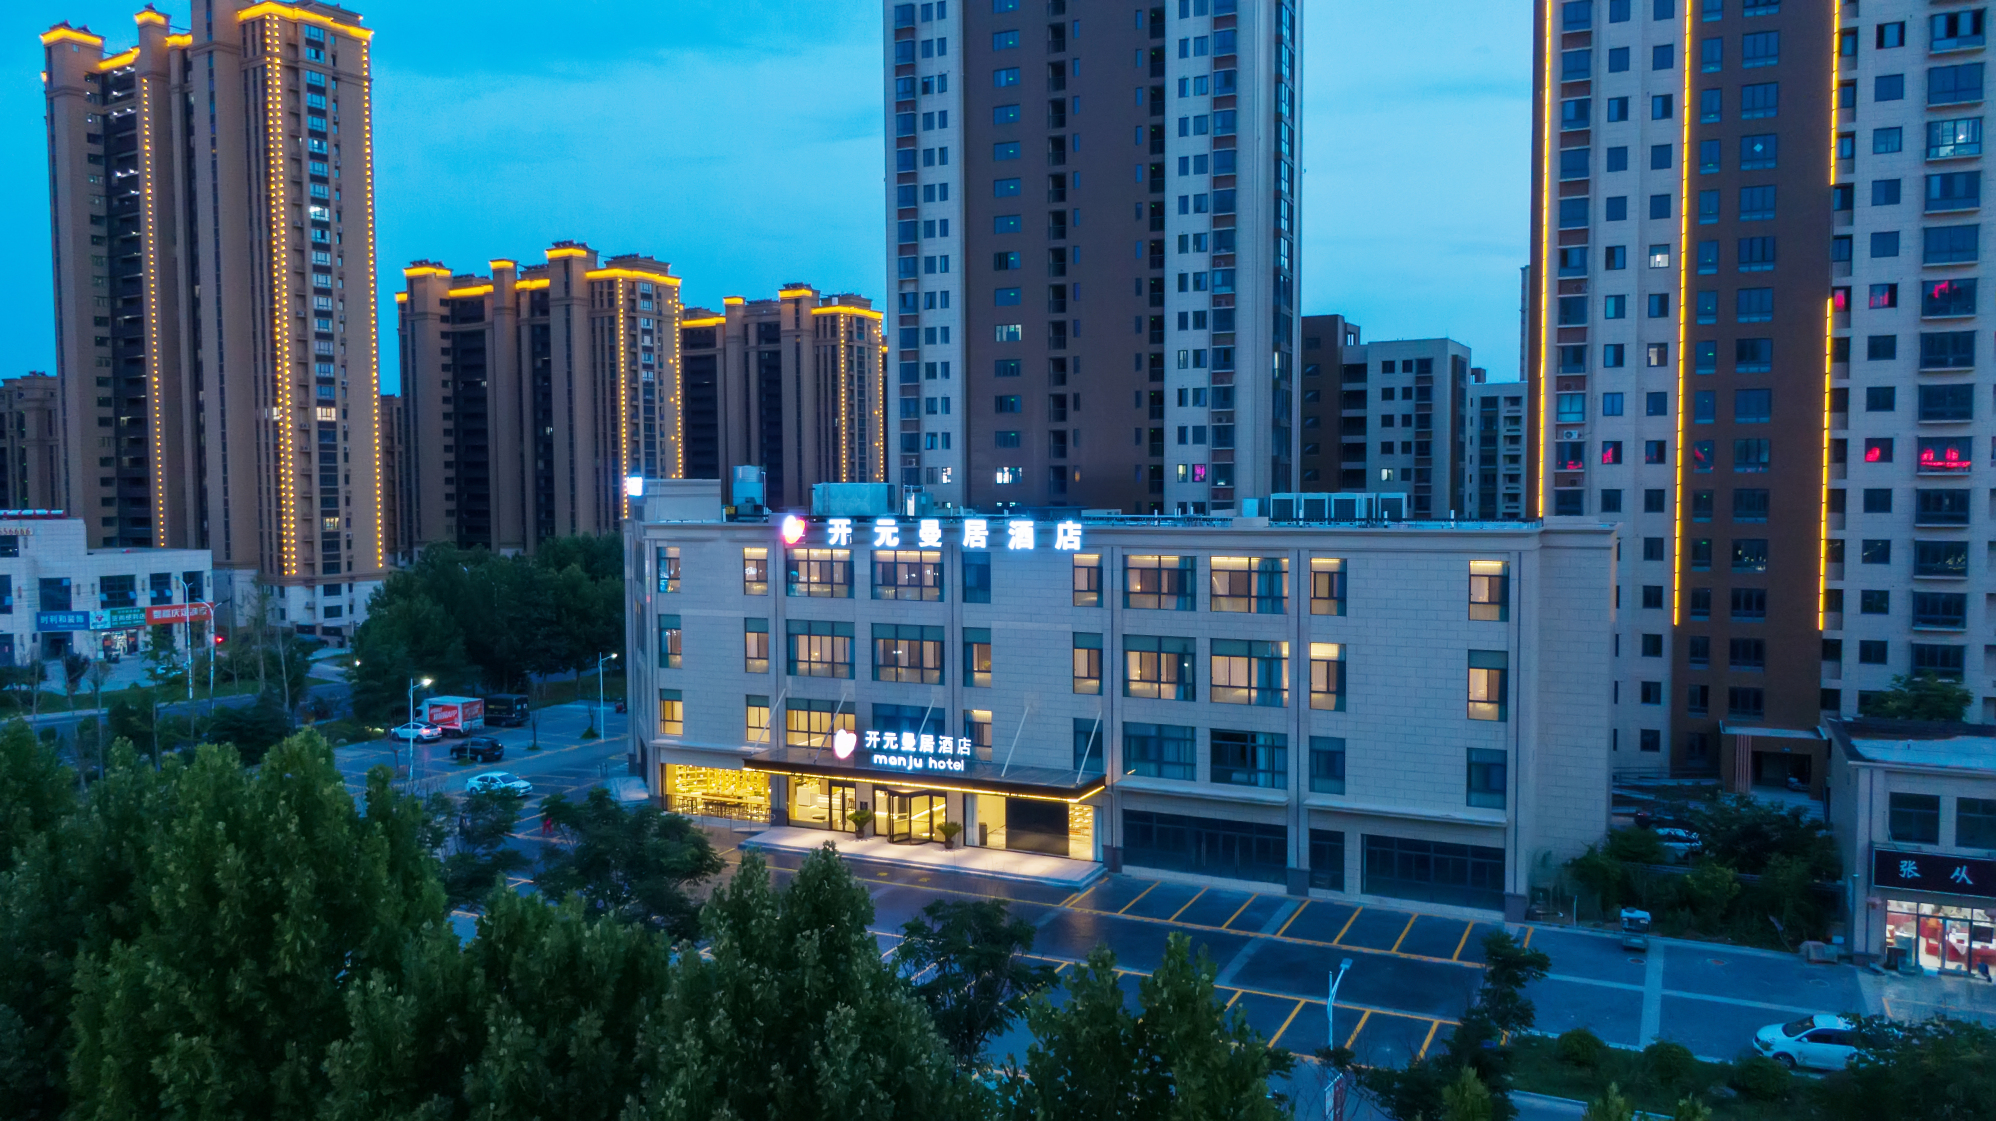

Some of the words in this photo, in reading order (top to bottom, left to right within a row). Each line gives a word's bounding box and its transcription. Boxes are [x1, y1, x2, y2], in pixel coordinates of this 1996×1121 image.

[828, 519, 1082, 550] 开元曼居酒店
[865, 731, 972, 756] 开元曼居酒店
[873, 754, 923, 770] manju
[928, 757, 964, 771] hotel
